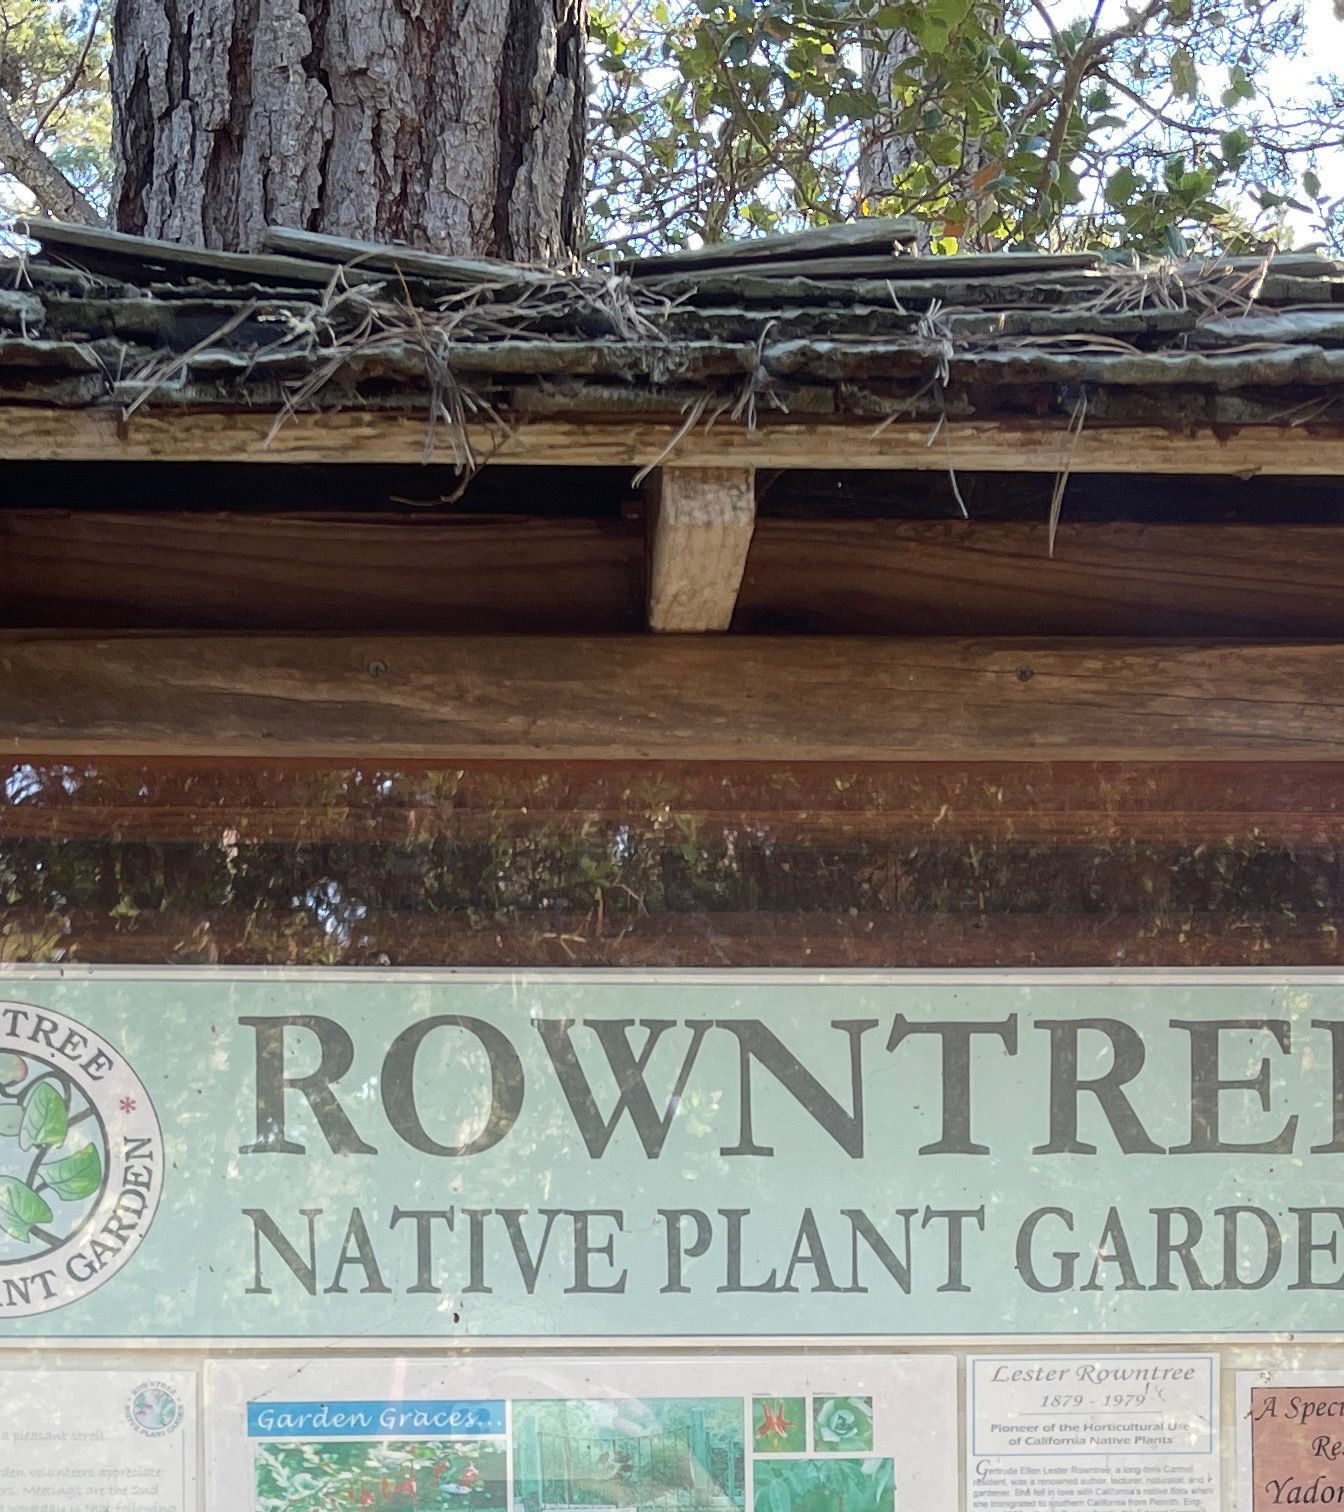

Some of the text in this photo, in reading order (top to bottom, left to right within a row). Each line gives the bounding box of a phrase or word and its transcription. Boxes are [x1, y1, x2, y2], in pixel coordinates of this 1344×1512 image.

[66, 1136, 153, 1282] GARDEN
[243, 1208, 628, 1296] NATIVE
[659, 1206, 985, 1295] PLANT
[991, 1365, 1195, 1384] Lester Rowntree
[1041, 1395, 1083, 1408] 1879
[1103, 1394, 1145, 1407] 1979
[1255, 1396, 1277, 1420] A
[258, 1407, 502, 1431] Garden Graces...
[991, 1423, 1189, 1433] Pioneer of the Horticultural Use
[1009, 1436, 1173, 1446] of California Native Plants
